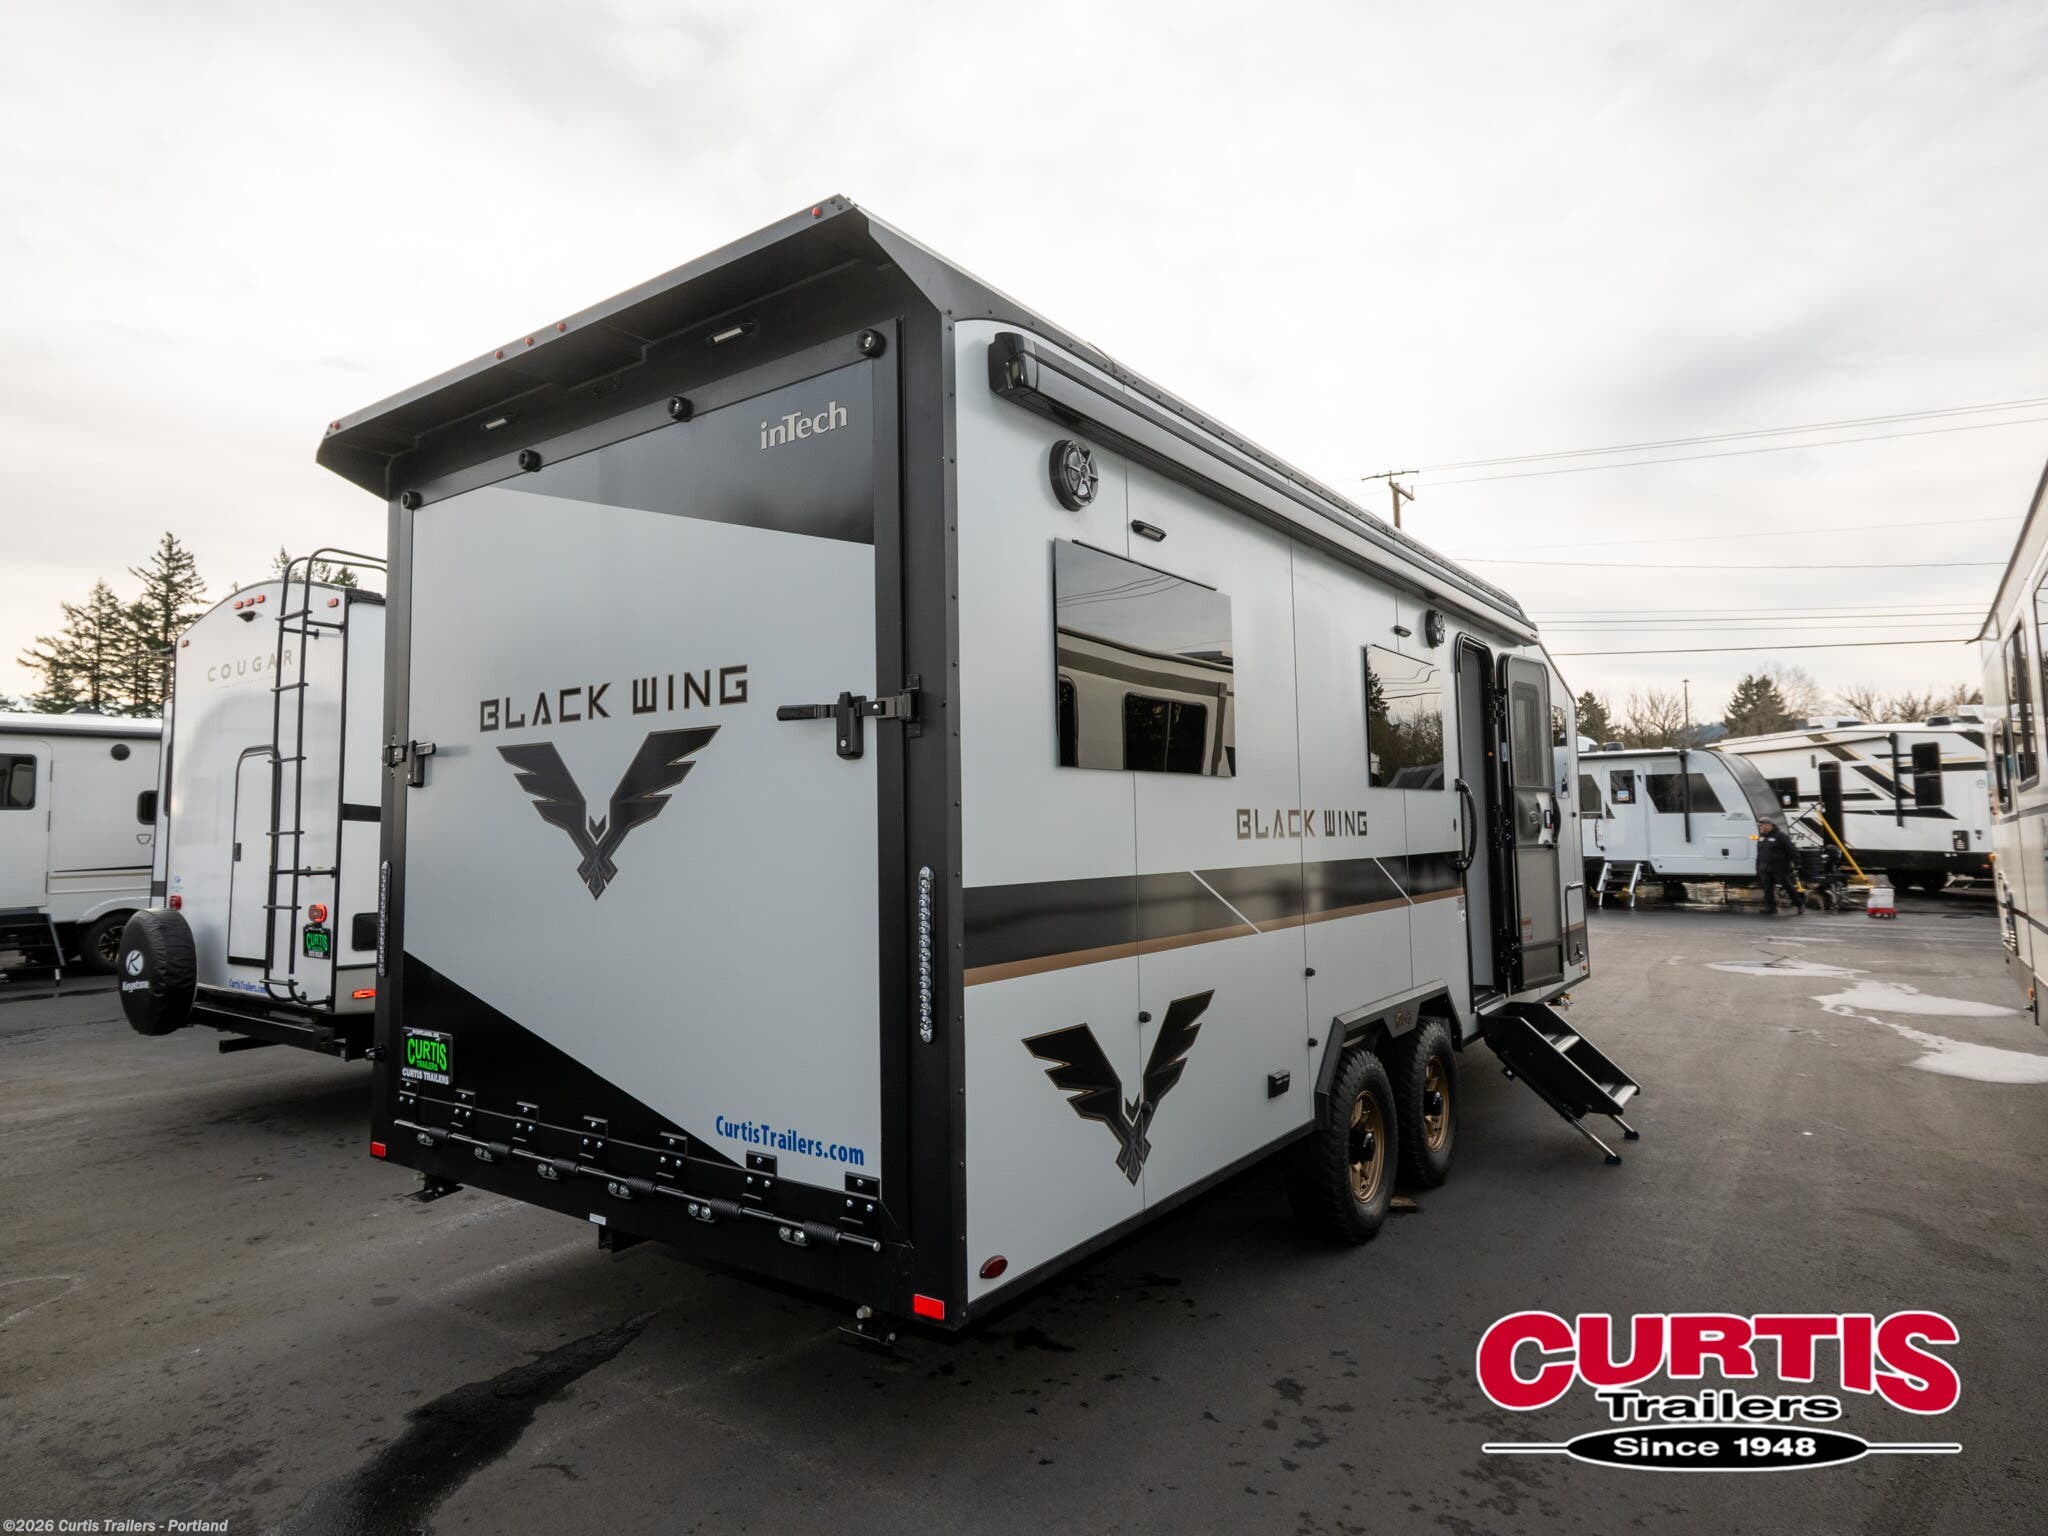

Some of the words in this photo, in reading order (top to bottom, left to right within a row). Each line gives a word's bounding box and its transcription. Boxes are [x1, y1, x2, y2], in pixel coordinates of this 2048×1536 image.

[761, 400, 847, 450] inTech
[207, 649, 292, 682] COUGAR
[480, 682, 611, 732] BLACK
[632, 664, 748, 715] WING
[1236, 808, 1316, 840] BLACK
[1324, 809, 1368, 837] WING
[306, 932, 328, 952] CURTIS
[407, 1038, 447, 1071] CURTIS
[402, 1067, 423, 1080] CURTIS
[423, 1071, 450, 1085] TRAILERS
[716, 1115, 865, 1166] CurtisTrailers.com
